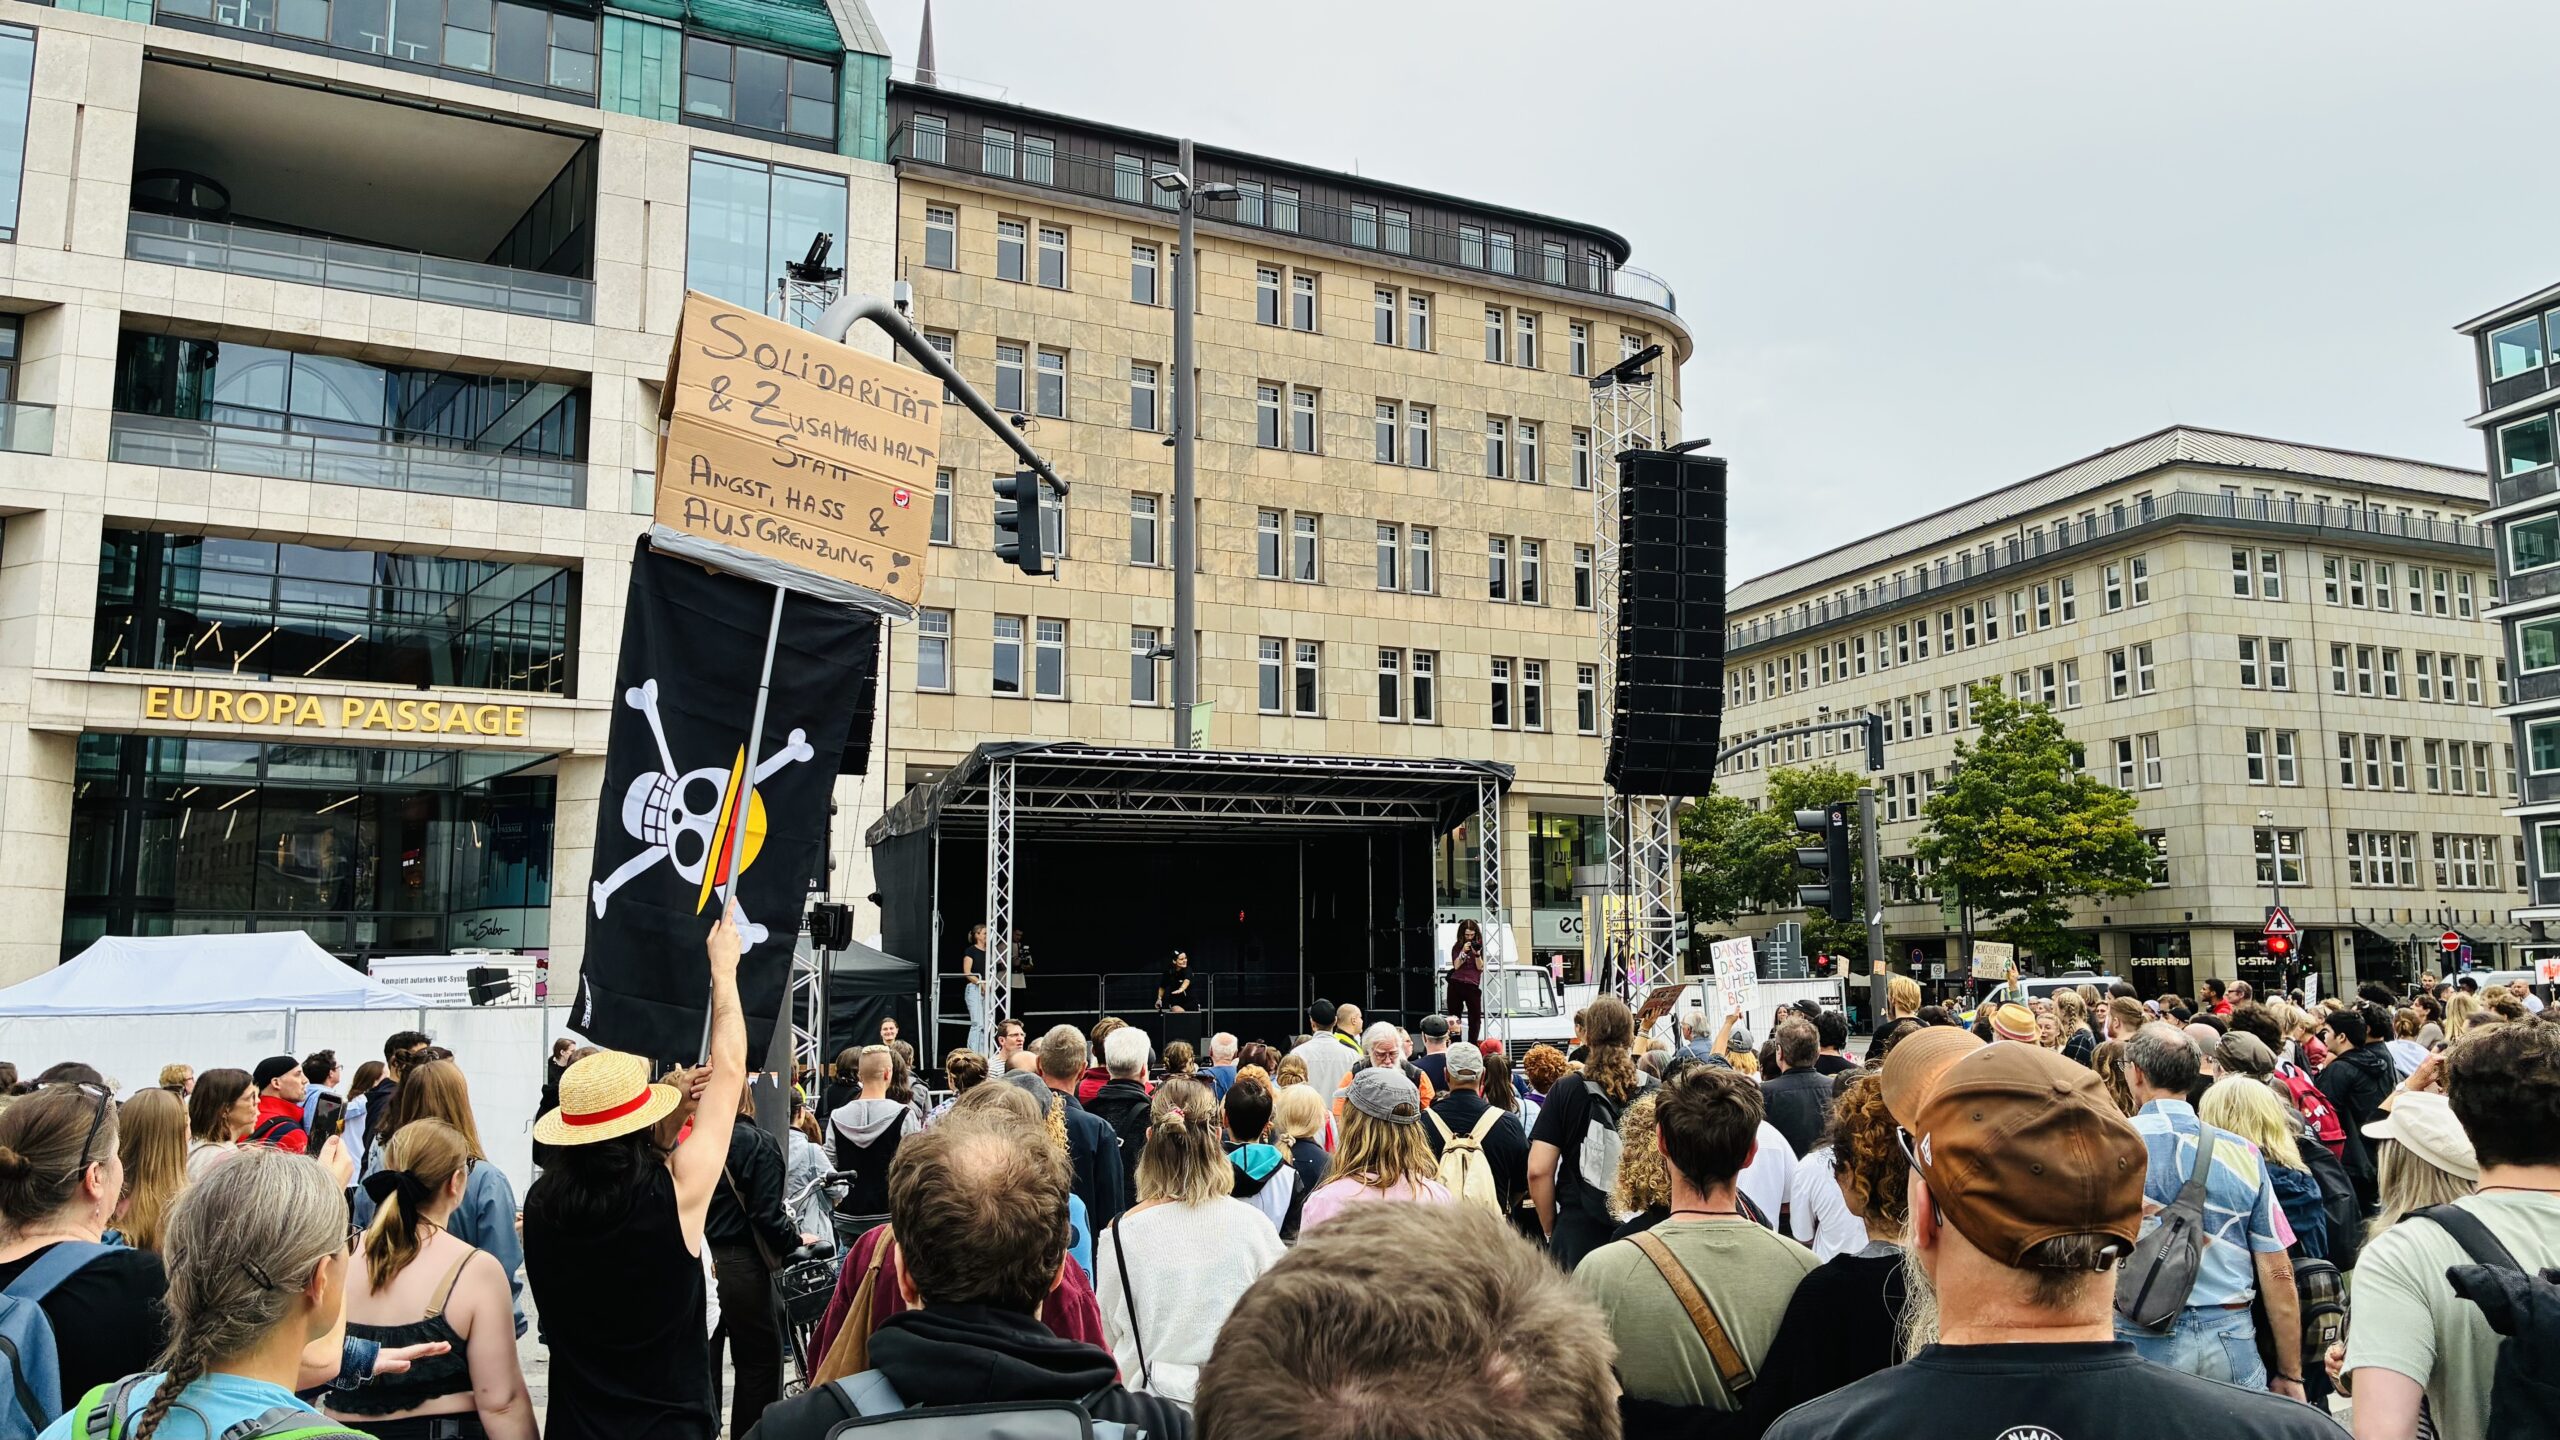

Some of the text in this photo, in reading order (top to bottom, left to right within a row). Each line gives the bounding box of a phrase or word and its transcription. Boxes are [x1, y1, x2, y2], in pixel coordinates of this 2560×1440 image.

[708, 375, 734, 413] &
[772, 433, 864, 483] STATT
[689, 454, 890, 538] ANGST, HASS &
[684, 496, 875, 573] AUSGRENZUNG
[145, 686, 527, 737] EUROPA PASSAGE
[1712, 940, 1751, 960] DANKE
[2130, 957, 2191, 966] G-STAR RAW
[1719, 957, 1749, 975] DASS
[381, 977, 409, 985] Komplett
[1727, 987, 1752, 1006] BIST
